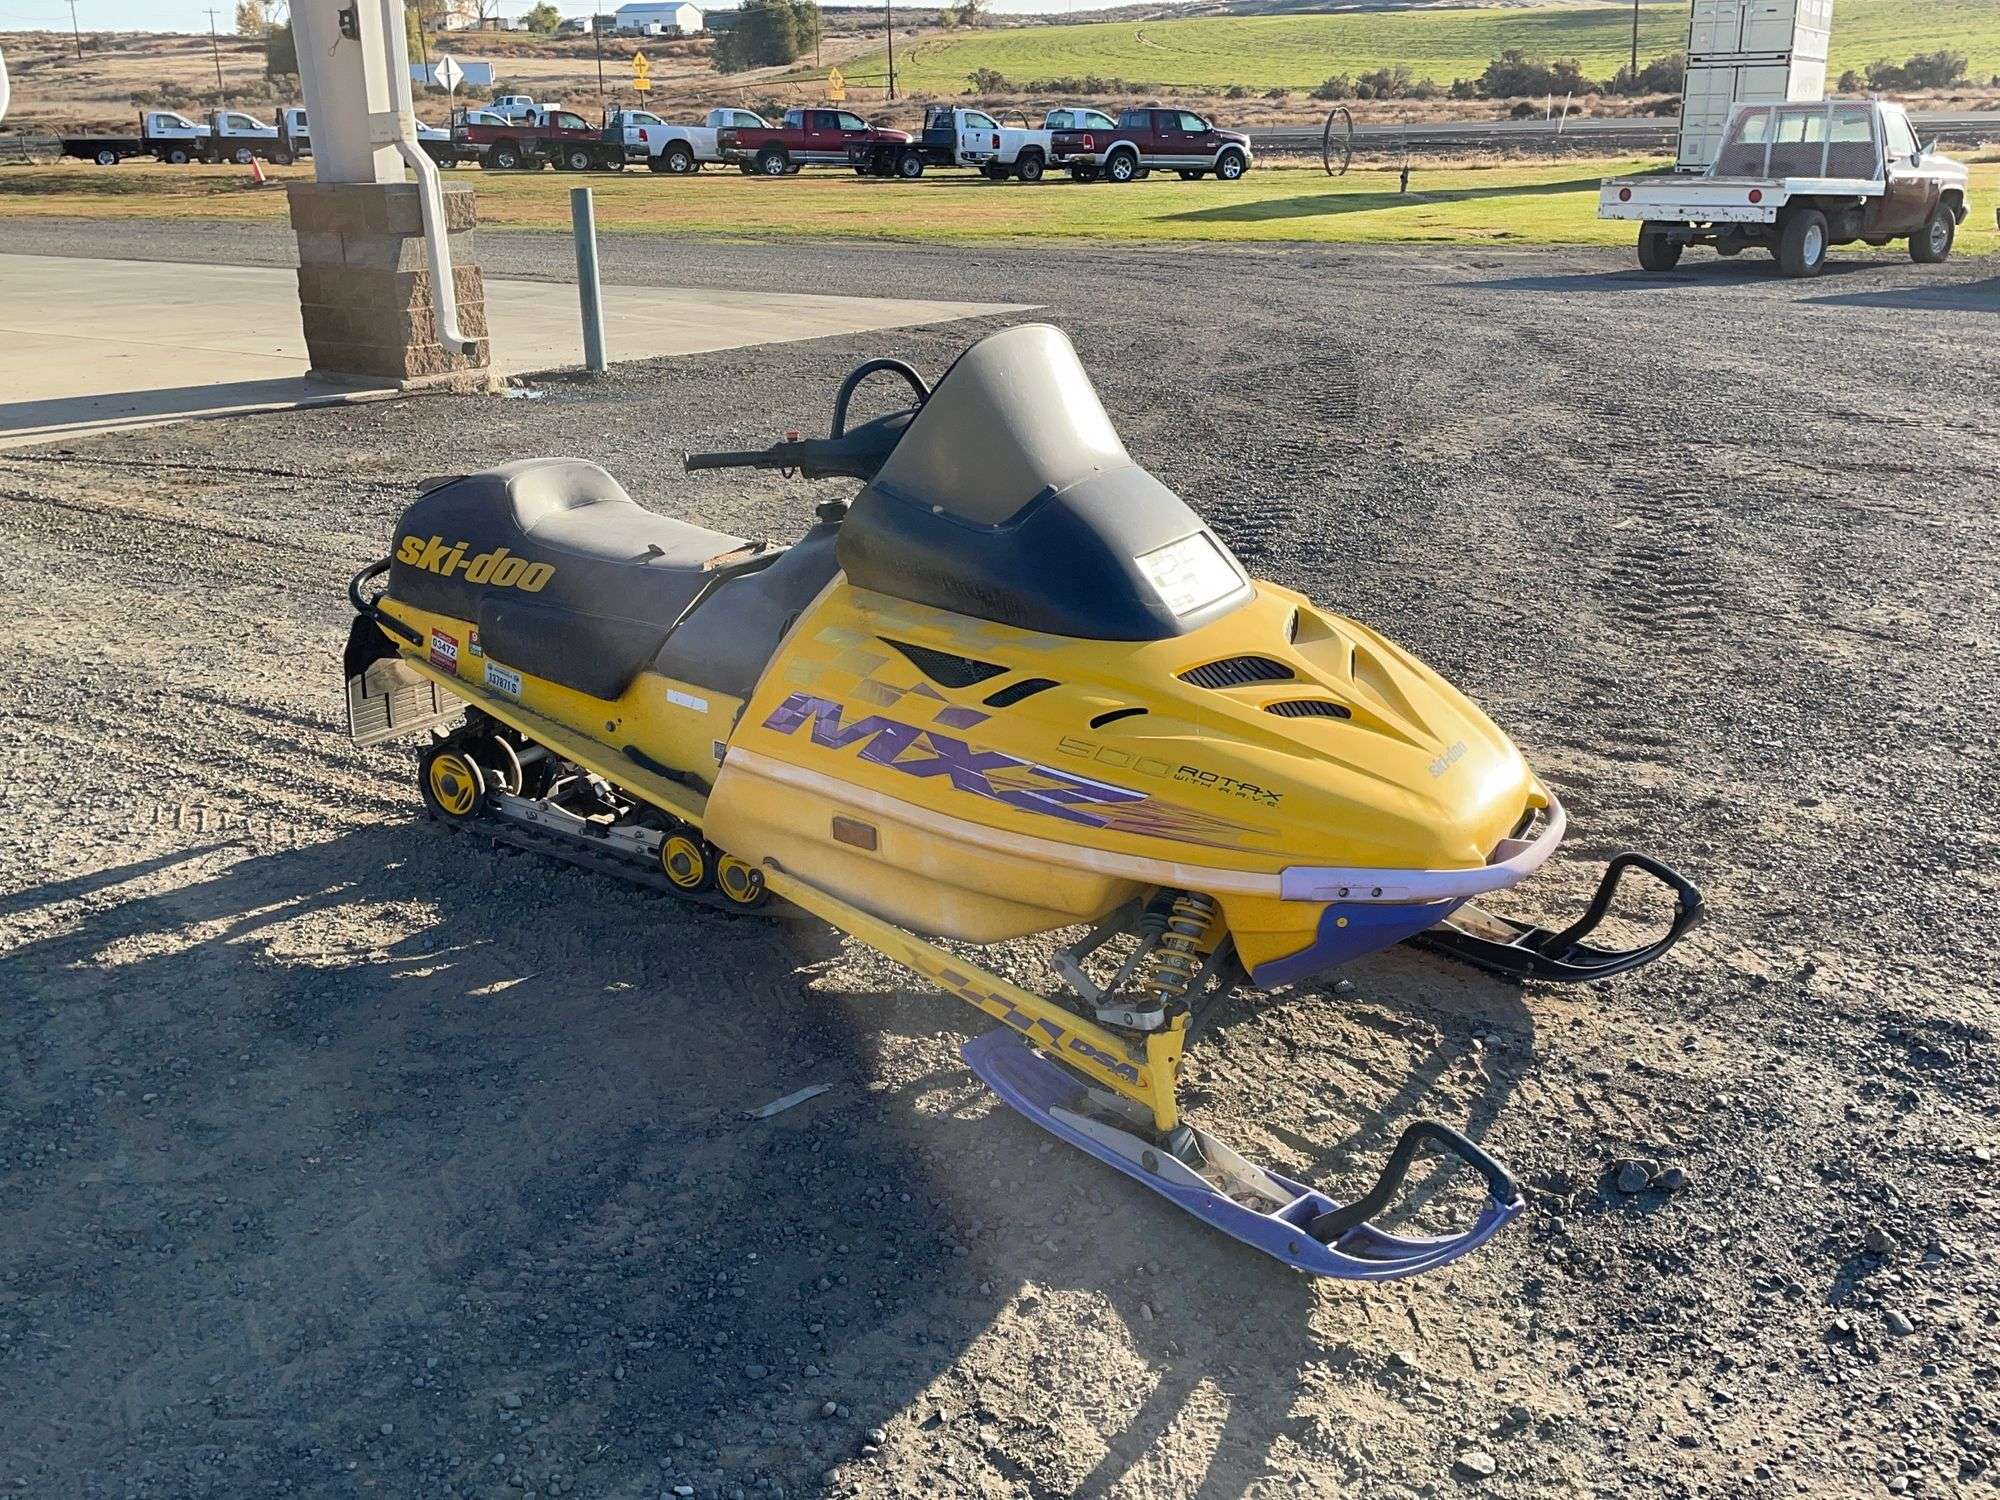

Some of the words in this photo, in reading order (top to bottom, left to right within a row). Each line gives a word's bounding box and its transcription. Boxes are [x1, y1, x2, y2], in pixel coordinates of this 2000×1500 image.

[396, 535, 556, 593] ski-doo
[1056, 736, 1171, 779] 500
[1178, 765, 1284, 802] ROTAX
[1173, 774, 1212, 788] WITH
